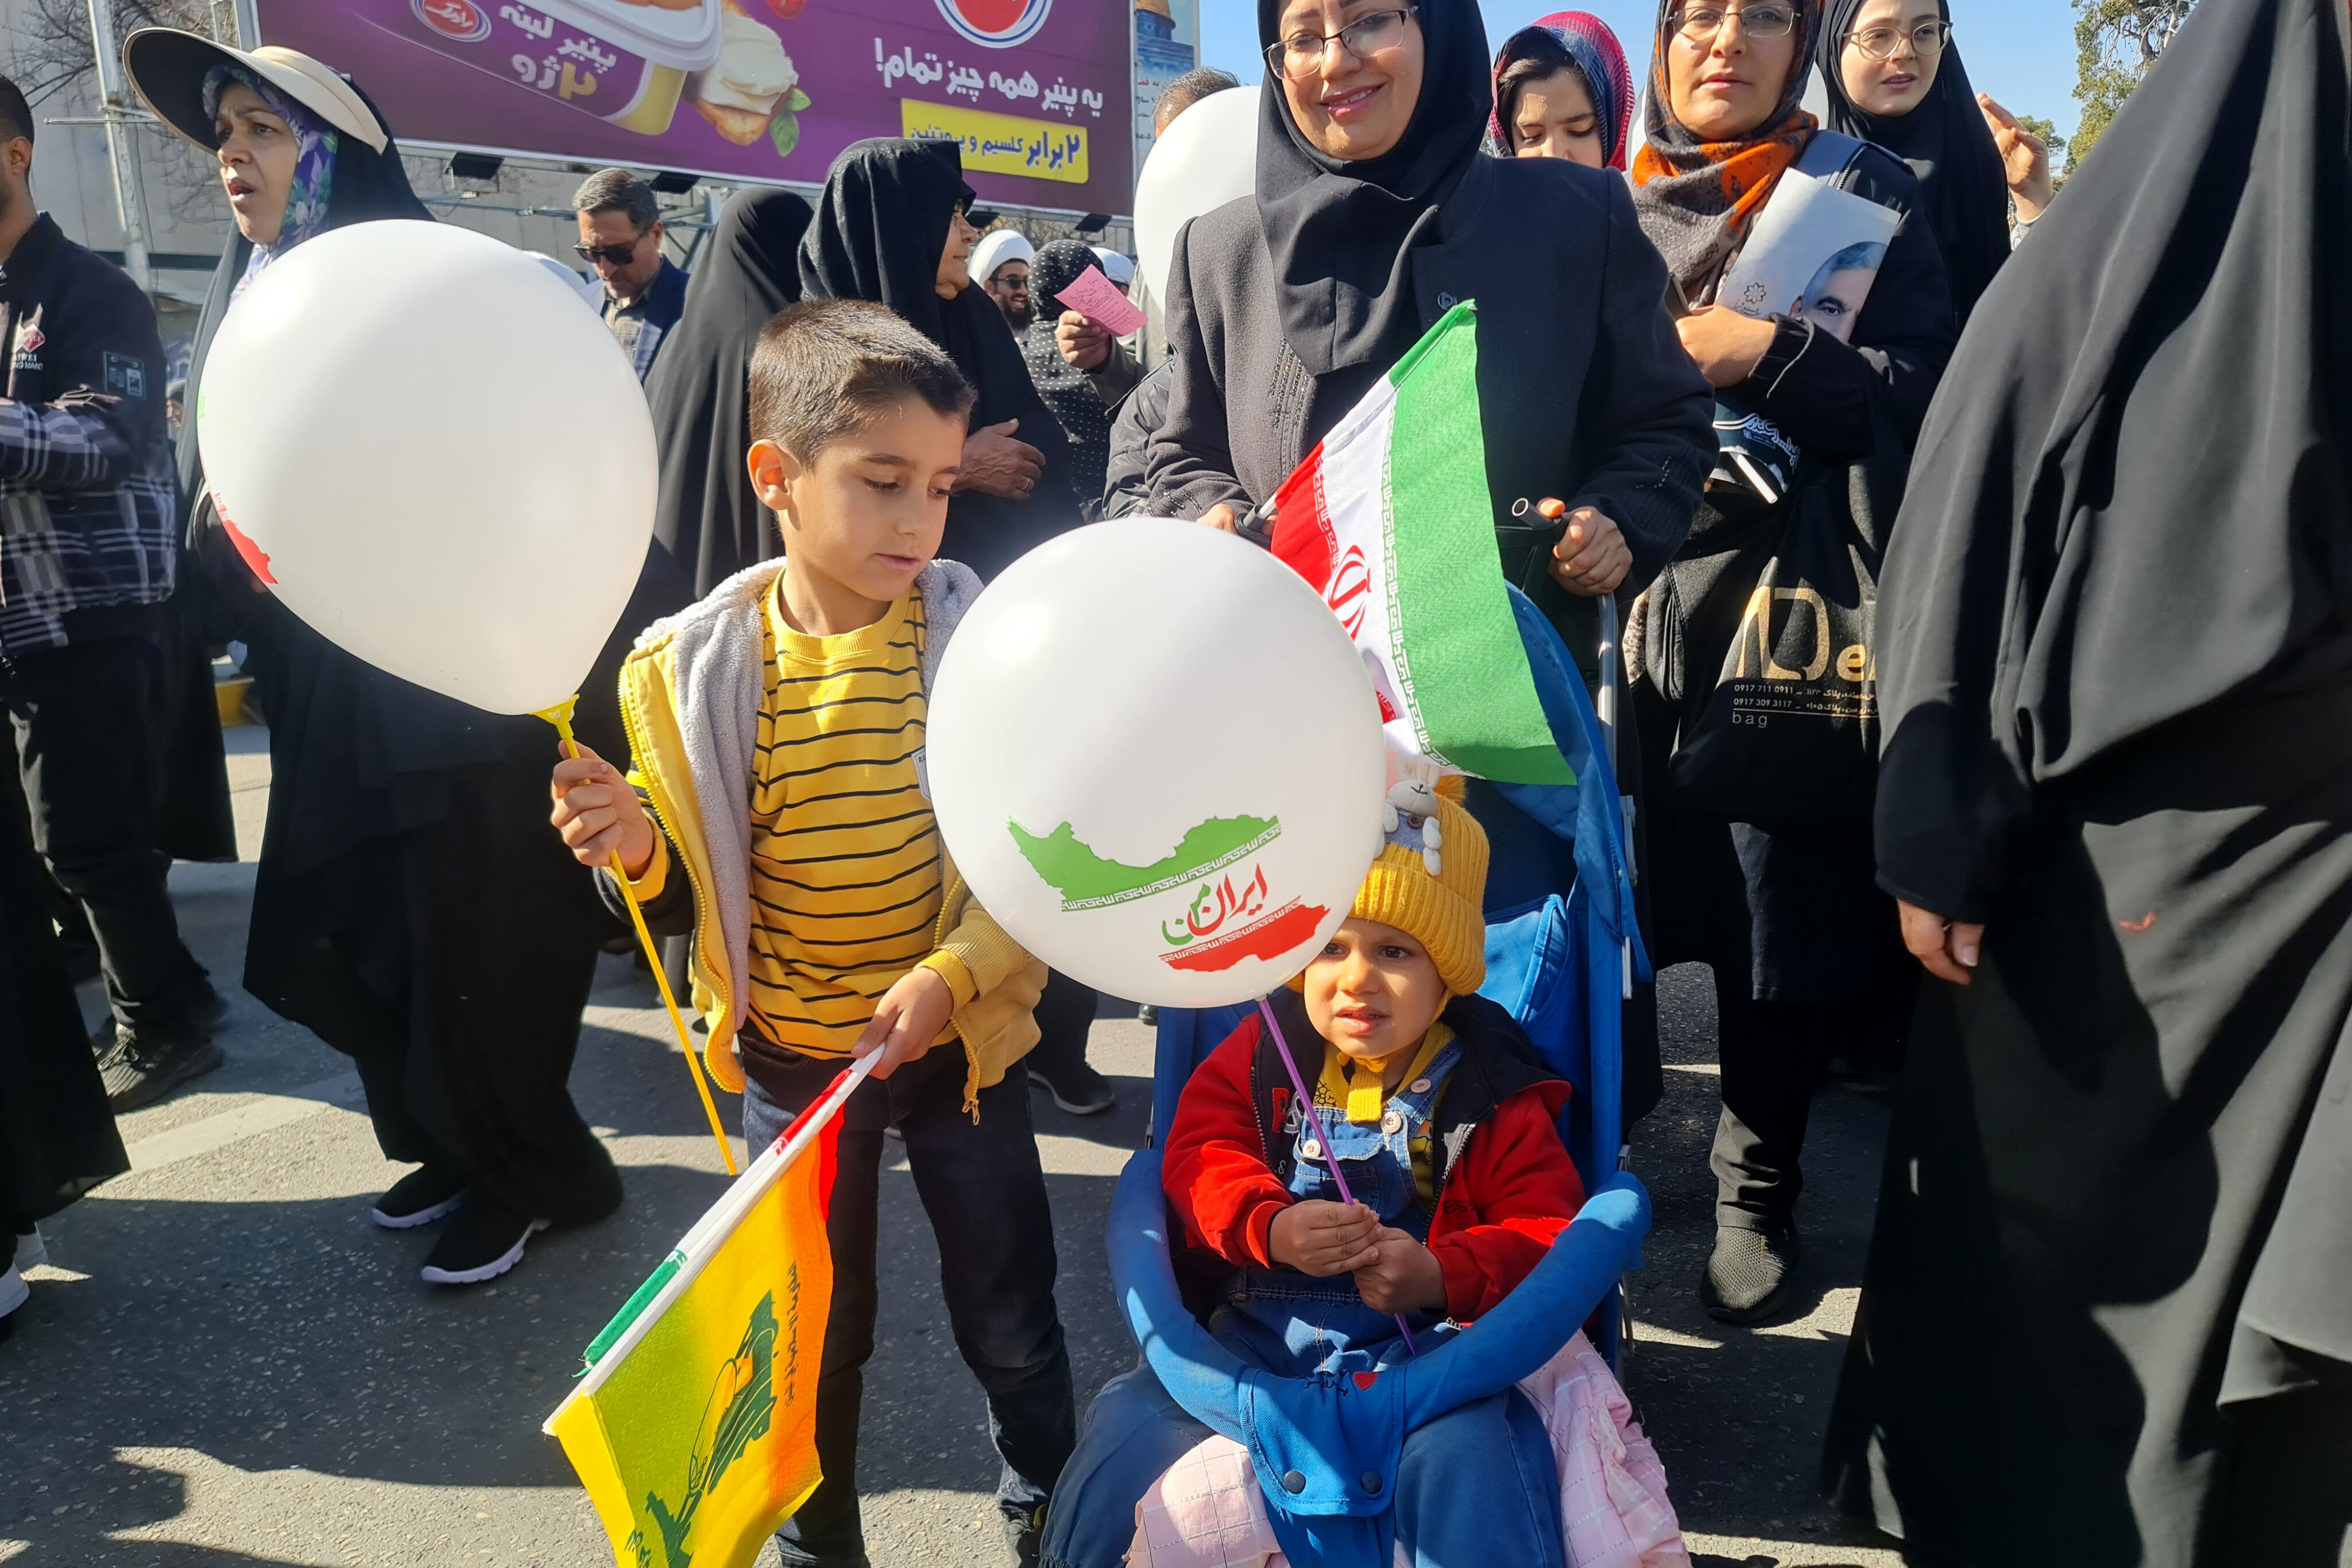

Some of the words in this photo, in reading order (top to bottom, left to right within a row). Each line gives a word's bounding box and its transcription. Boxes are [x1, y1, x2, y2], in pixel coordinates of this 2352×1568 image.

[500, 5, 554, 40] لبنه
[556, 37, 617, 74] پنیر
[875, 38, 942, 88] تمام!
[946, 60, 984, 102] چیز
[989, 71, 1039, 99] همه
[1041, 77, 1078, 118] پنیر
[1082, 88, 1102, 118] یه
[970, 135, 977, 153] و
[982, 137, 1023, 157] کلسیم
[1026, 131, 1063, 170] برابر
[1066, 134, 1080, 164] ۲
[1773, 699, 1792, 707] 3117
[1774, 686, 1793, 694] 0911
[1732, 712, 1767, 728] bag
[1162, 882, 1211, 946] من
[1187, 862, 1267, 936] ایران
